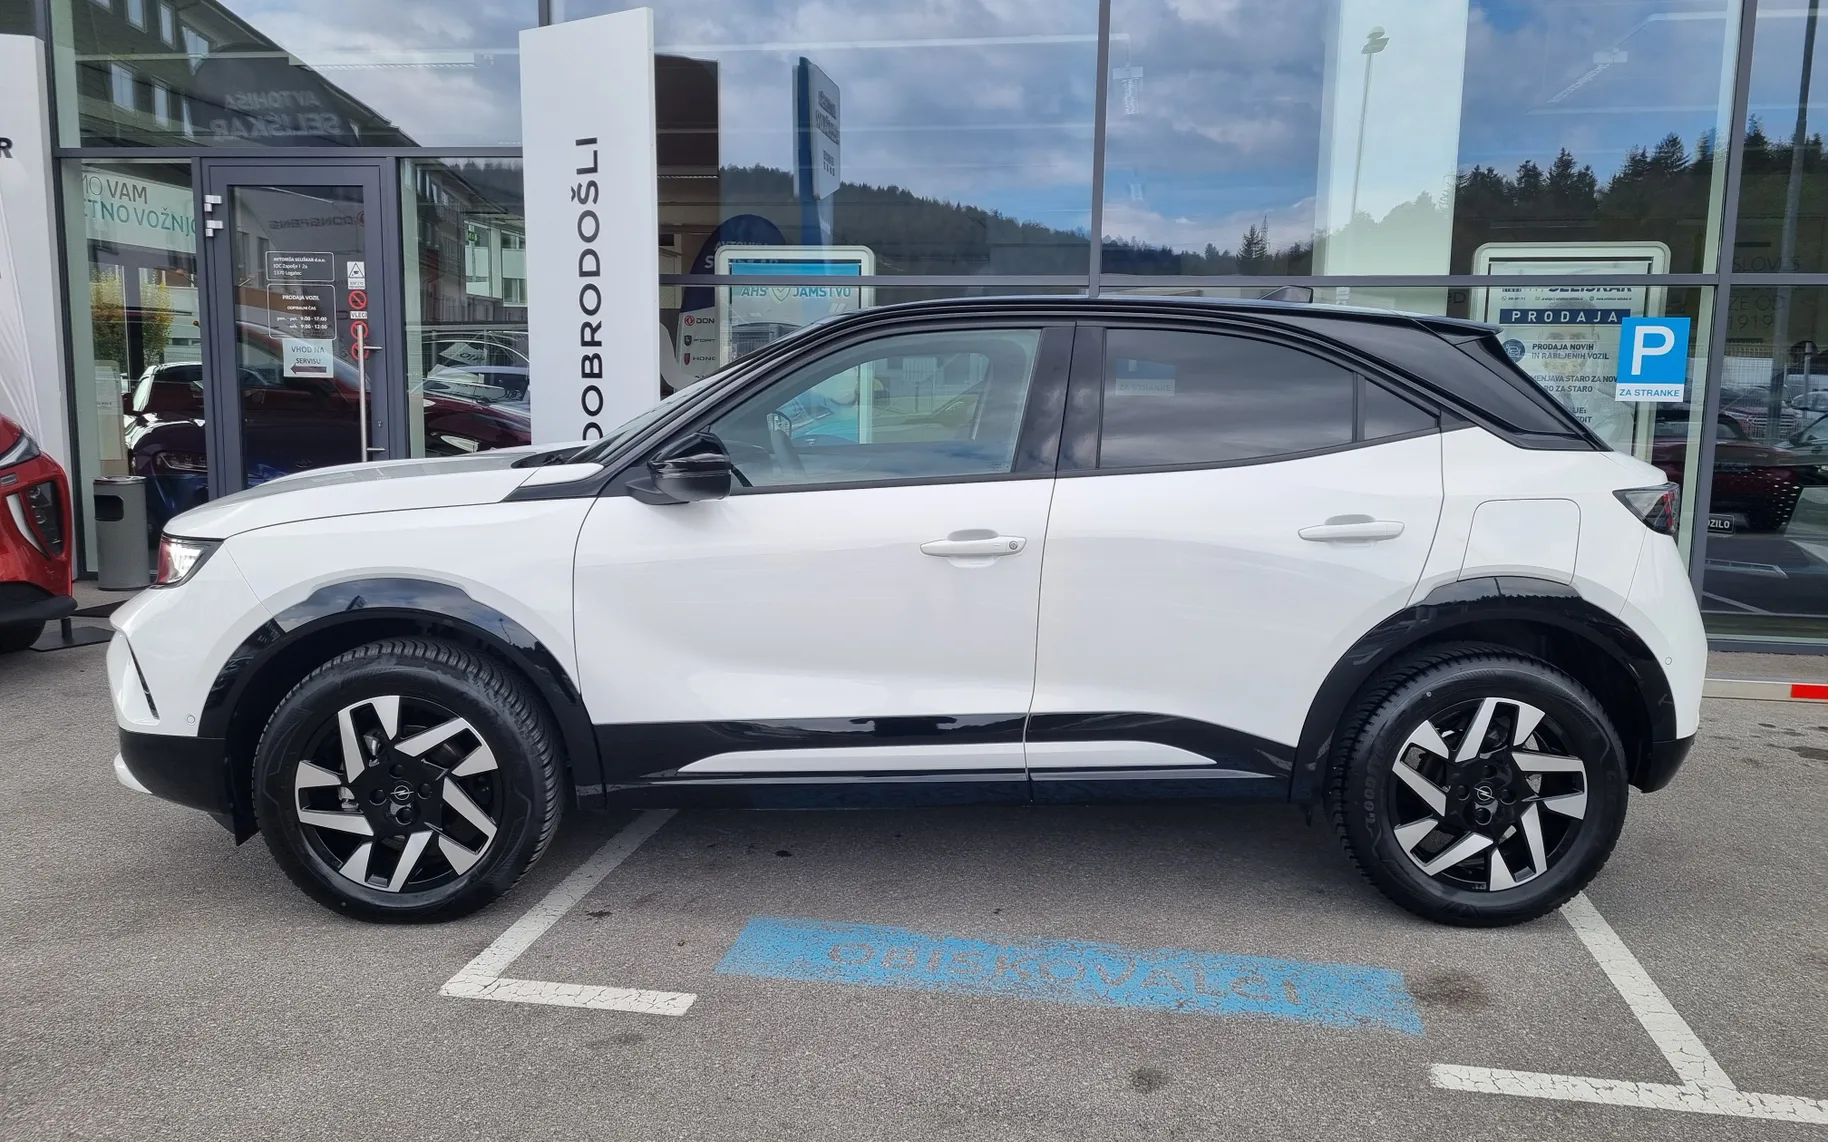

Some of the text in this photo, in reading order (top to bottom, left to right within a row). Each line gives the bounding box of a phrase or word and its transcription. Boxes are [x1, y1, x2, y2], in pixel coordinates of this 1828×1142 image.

[106, 179, 148, 205] VAM
[793, 286, 851, 298] JAMSTVO
[1512, 311, 1618, 322] PRODAJA
[1532, 343, 1594, 351] PRODAJA NOVIH
[1631, 326, 1675, 376] P
[1531, 352, 1609, 360] IN RABLJENIH VOZIL
[1619, 389, 1681, 397] ZA STRANKE
[827, 941, 1301, 1005] OBISKOVALCI
